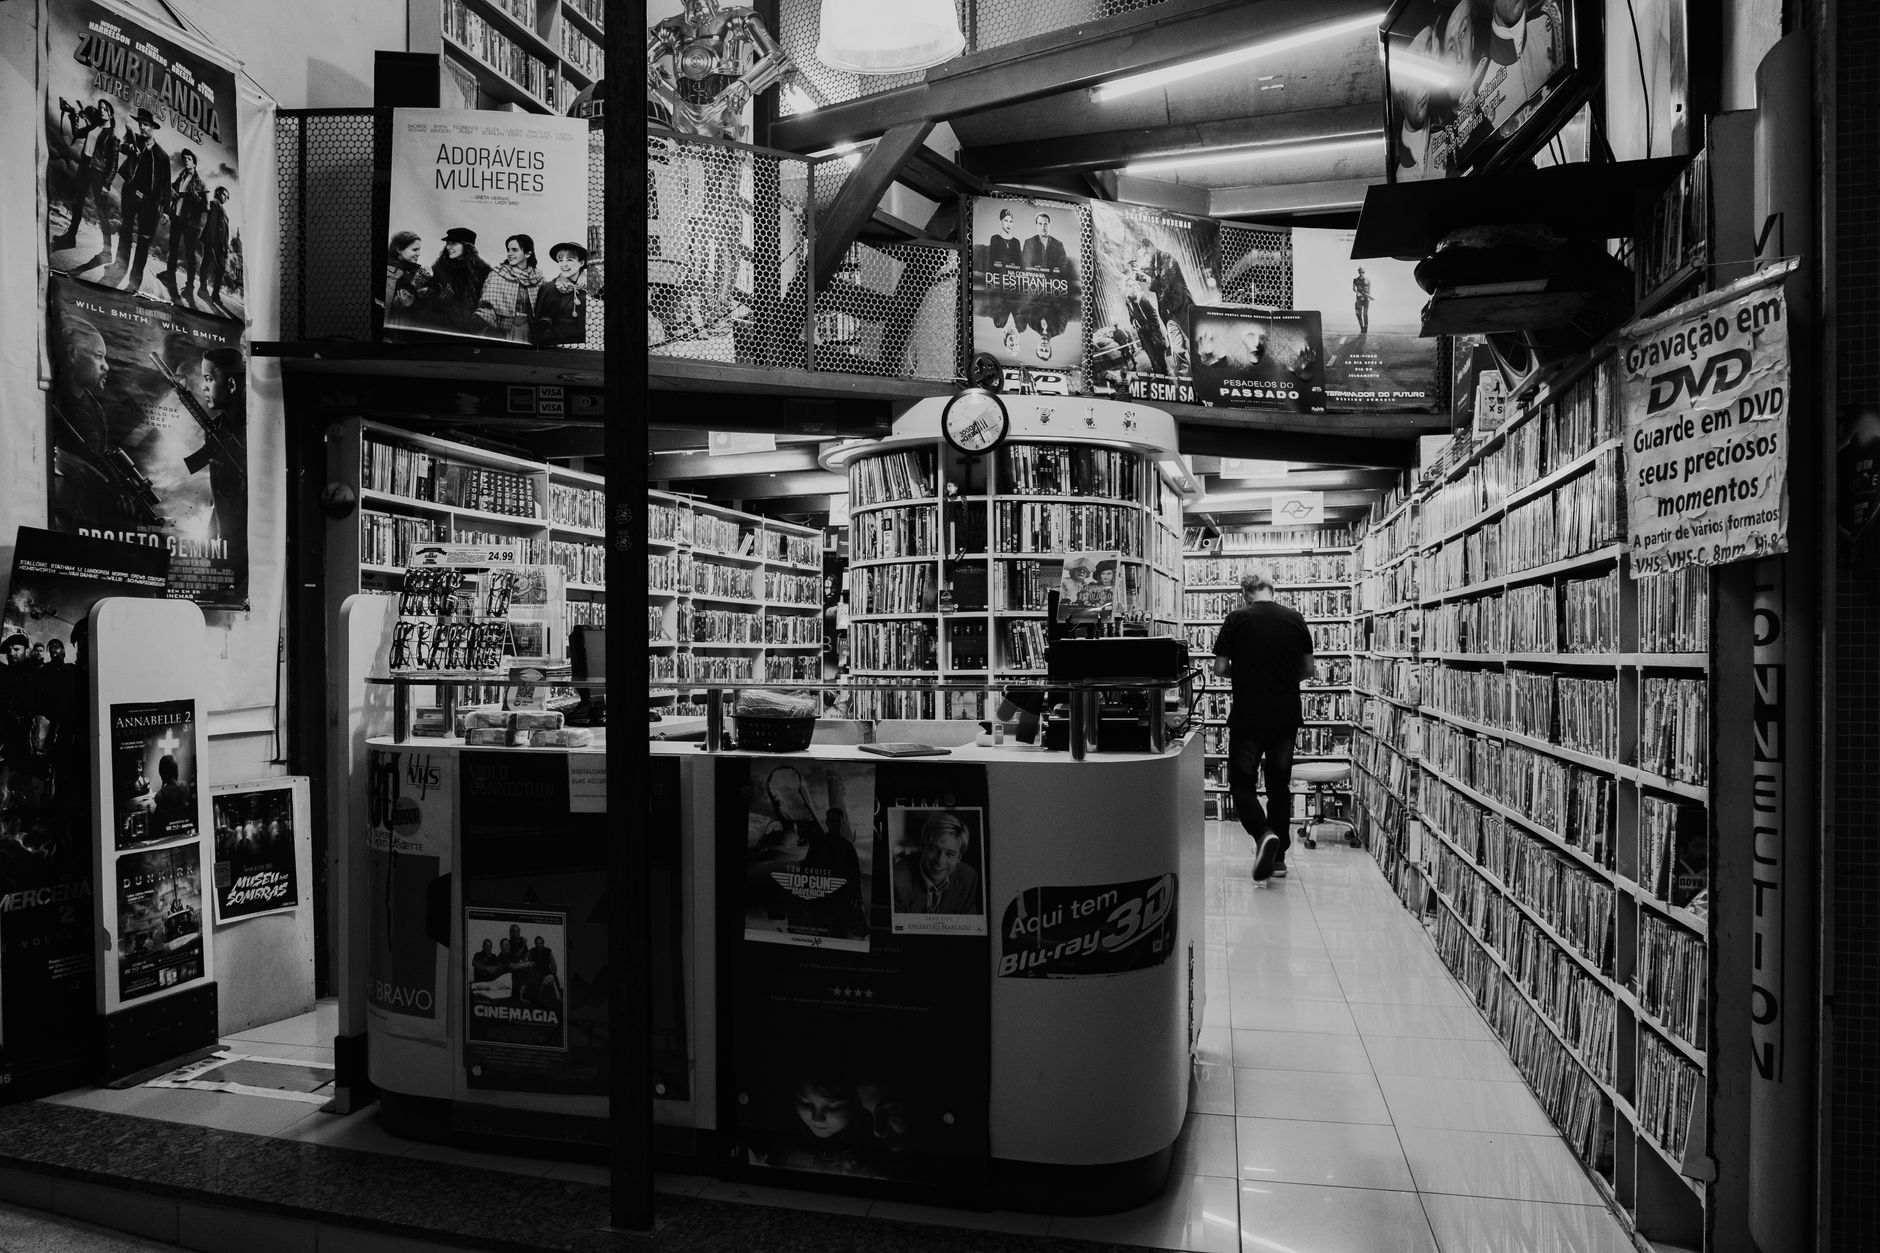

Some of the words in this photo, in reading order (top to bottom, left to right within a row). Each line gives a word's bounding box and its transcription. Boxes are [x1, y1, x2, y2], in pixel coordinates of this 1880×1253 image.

[73, 32, 222, 144] ZUMBILÂNDIA
[94, 71, 130, 102] ATIRE
[169, 108, 204, 145] VEZES
[436, 143, 545, 170] ADORÁVEIS
[435, 167, 544, 193] MULHERES
[985, 272, 1000, 285] DE
[1002, 273, 1068, 290] ESTRANHOS
[75, 300, 105, 314] WILL
[110, 309, 149, 324] SMITH
[161, 321, 189, 334] WILL
[192, 329, 226, 343] SMITH
[1625, 314, 1730, 375] Gravação
[1737, 296, 1782, 335] em
[541, 388, 563, 397] VISA
[1150, 383, 1176, 401] SEM
[1179, 385, 1196, 403] SA
[1220, 387, 1300, 400] PASSADO
[1223, 379, 1278, 389] PESADELOS
[1280, 381, 1294, 389] DO
[1325, 390, 1376, 398] TERMINADOR
[1646, 348, 1753, 416] DVD
[541, 404, 563, 413] VISA
[1633, 414, 1695, 454] Guarde
[1701, 409, 1732, 435] em
[1738, 387, 1783, 424] DVD
[1638, 460, 1678, 488] seus
[1684, 432, 1778, 485] preciosos
[1657, 476, 1760, 519] momentos
[1633, 534, 1642, 549] A
[1644, 527, 1672, 550] partir
[1675, 524, 1690, 541] de
[1692, 518, 1724, 537] vários
[166, 536, 228, 560] GEMINI
[488, 551, 513, 561] 24.99
[20, 559, 48, 568] STALLONE
[50, 563, 75, 571] STATHAM
[116, 712, 182, 729] ANNABELLE
[184, 711, 192, 723] 2
[408, 767, 439, 785] VHS
[1752, 582, 1781, 1084] ONNECTION
[123, 865, 194, 889] DUNKIRK
[231, 871, 280, 892] MUSEU
[786, 865, 801, 873] TOM
[804, 866, 832, 876] CRUISE
[789, 873, 808, 888] TOP
[809, 875, 832, 890] GUN
[1679, 875, 1704, 887] novo
[0, 879, 92, 913] MERCENA
[226, 881, 289, 907] SOMBRAS
[791, 887, 826, 898] MAVERICK
[998, 930, 1101, 977] Blu-ray
[1101, 872, 1176, 953] 3D
[1009, 904, 1064, 940] Aqui
[1070, 889, 1119, 920] tem
[376, 980, 433, 1010] BRAVO
[473, 1004, 560, 1025] CINEMAGIA
